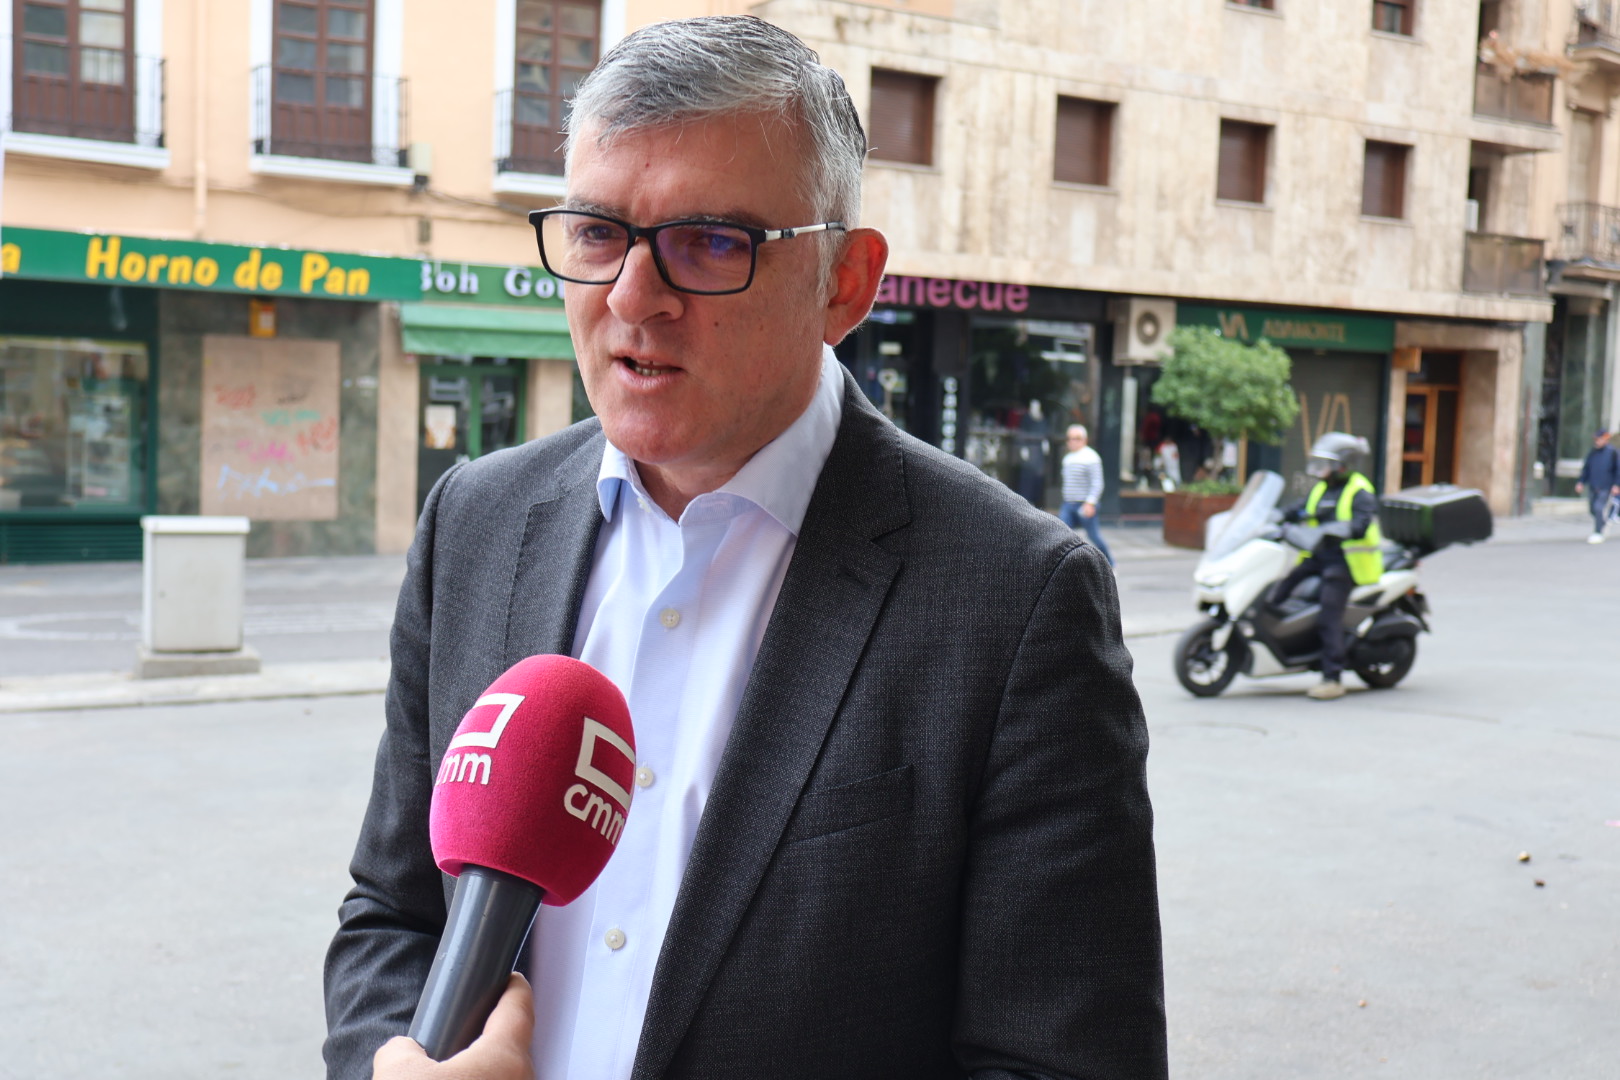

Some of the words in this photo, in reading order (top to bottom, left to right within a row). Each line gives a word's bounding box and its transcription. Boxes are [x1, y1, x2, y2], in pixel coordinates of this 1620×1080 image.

[86, 235, 219, 286] Horno
[233, 248, 283, 291] de
[300, 252, 370, 295] Pan
